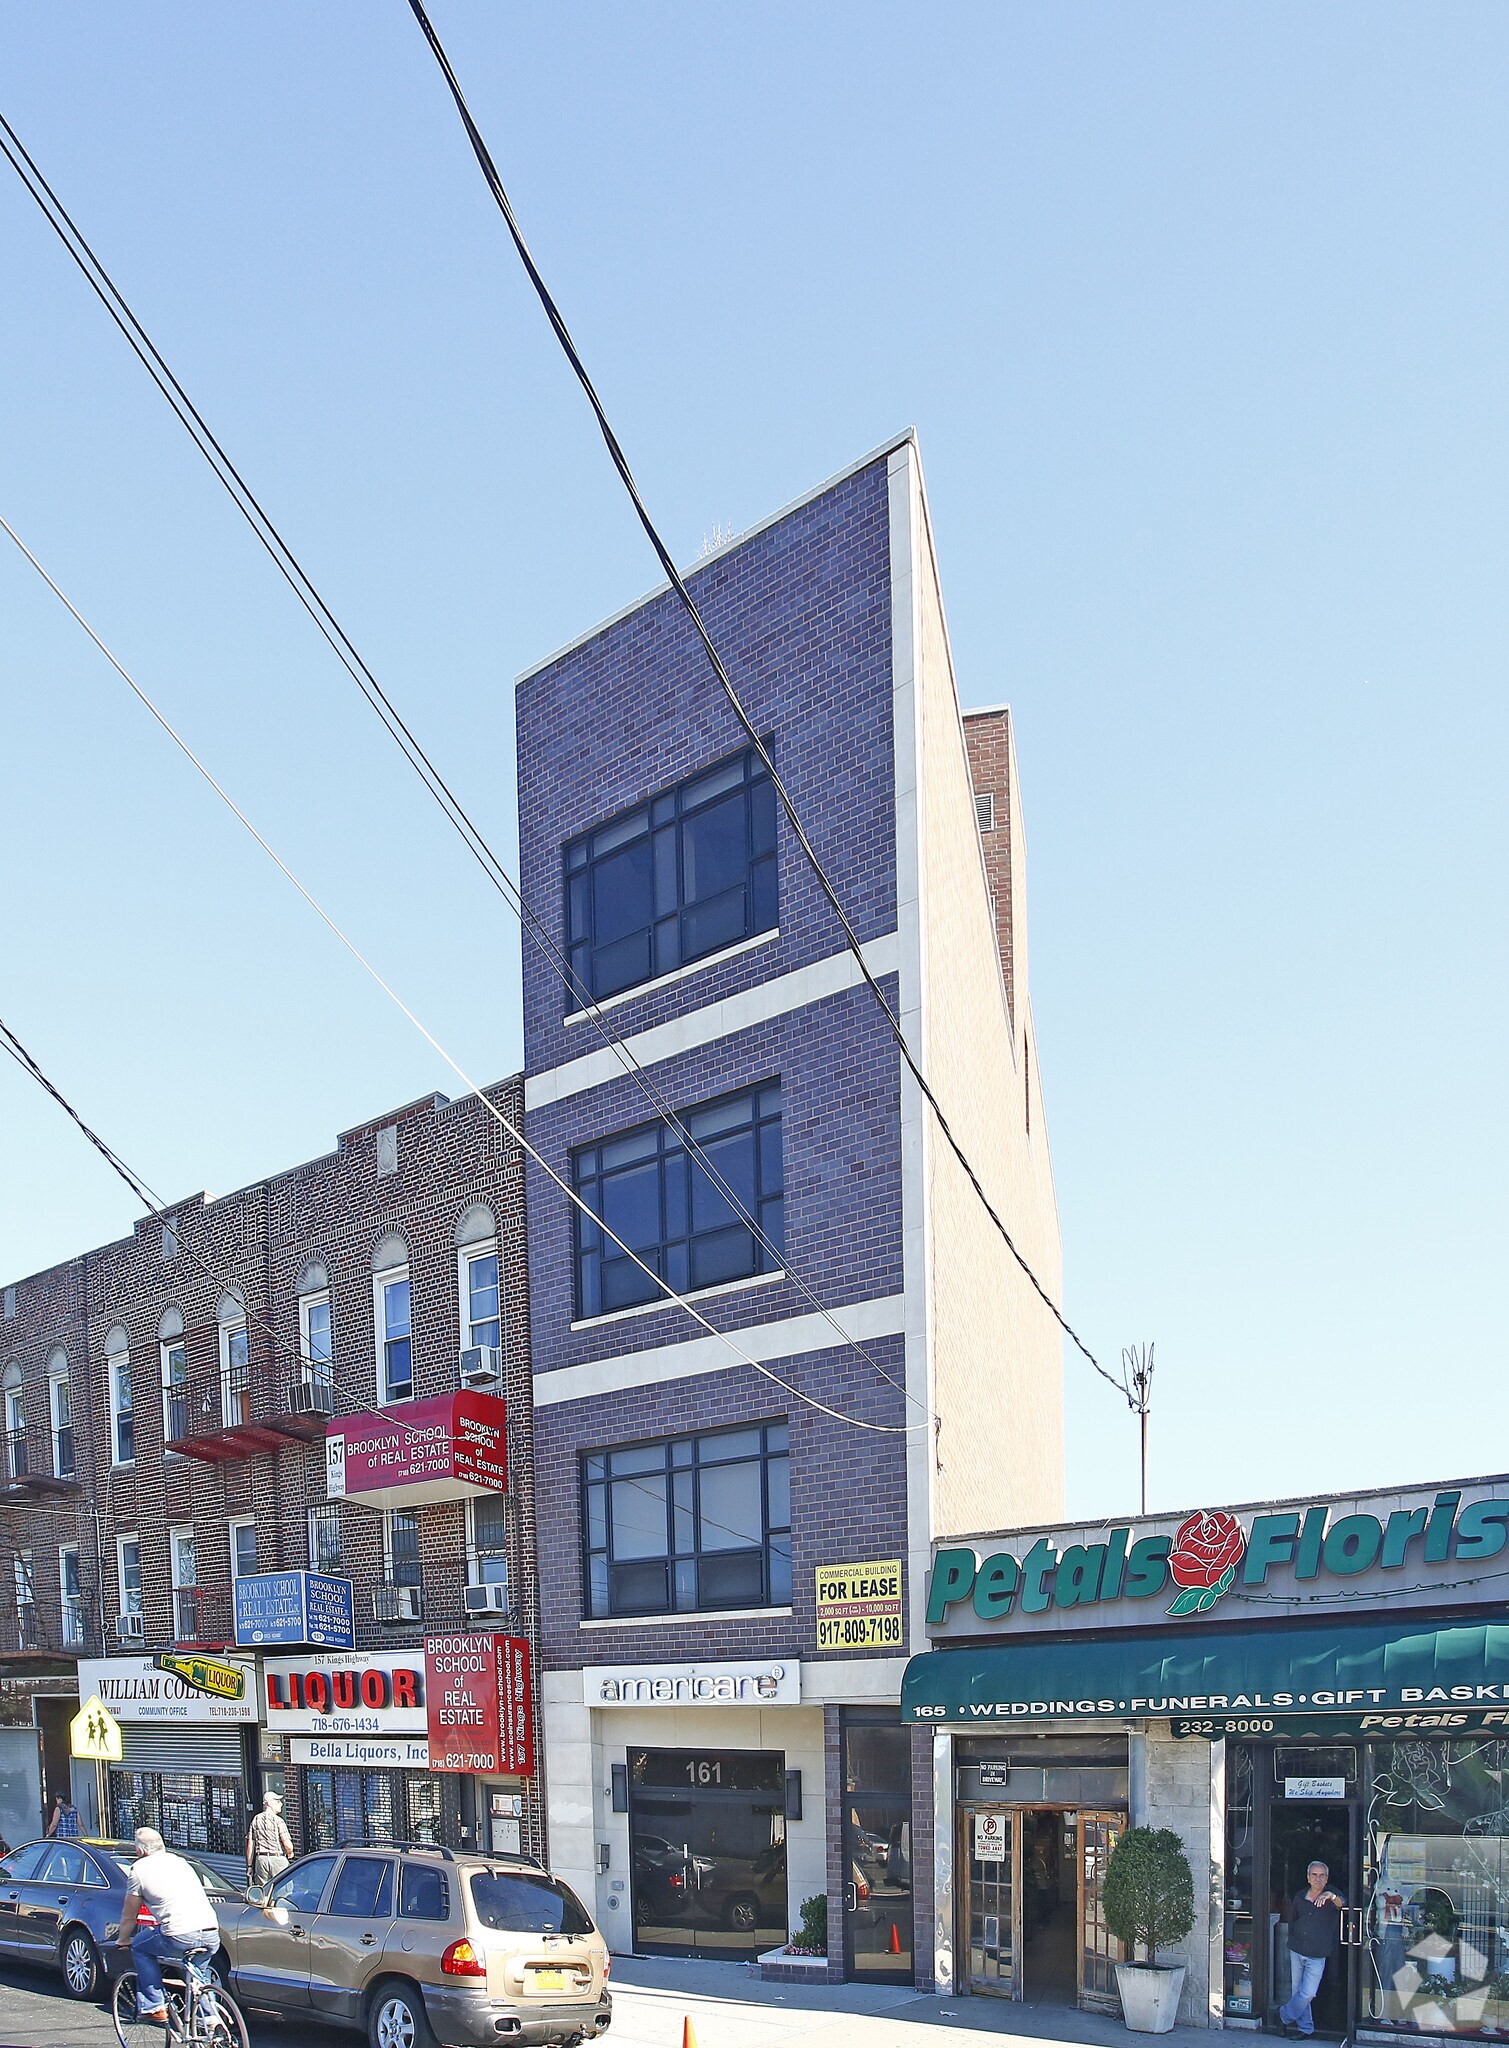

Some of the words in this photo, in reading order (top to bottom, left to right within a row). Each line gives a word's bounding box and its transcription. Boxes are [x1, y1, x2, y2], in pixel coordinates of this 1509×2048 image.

[459, 1416, 500, 1438] BROOKLYN
[347, 1434, 399, 1456] BROOKLYN
[404, 1425, 447, 1445] SCHOOL
[464, 1431, 497, 1449] SCHOOL
[327, 1441, 344, 1466] 157
[368, 1455, 379, 1468] of
[380, 1450, 407, 1465] REAL
[411, 1441, 449, 1460] ESTATE
[475, 1448, 483, 1457] of
[409, 1458, 450, 1474] 621-7000
[454, 1452, 475, 1466] REAL
[476, 1459, 504, 1476] ESTATE
[469, 1471, 503, 1489] 621-7000
[925, 1527, 1174, 1624] Petals
[1242, 1490, 1509, 1586] Floris
[819, 1568, 863, 1580] COMMERCIAL
[865, 1564, 897, 1576] BUILDING
[239, 1582, 272, 1599] BROOKLYN
[273, 1579, 299, 1597] SCHOOL
[309, 1579, 347, 1594] BROOKLYN
[819, 1582, 847, 1601] FOR
[851, 1577, 898, 1598] LEASE
[310, 1590, 346, 1604] SCHOOL
[243, 1601, 263, 1617] REAL
[265, 1598, 293, 1615] ESTATE
[309, 1602, 324, 1612] REAL
[325, 1604, 344, 1616] ESTATE
[820, 1606, 834, 1617] 2,000
[842, 1607, 848, 1615] FT
[865, 1604, 883, 1614] 10,000
[892, 1603, 899, 1611] FT
[276, 1617, 301, 1627] 621-5700
[318, 1614, 351, 1627] 621-7000
[318, 1622, 351, 1635] 621-5700
[819, 1616, 899, 1645] 917-809-7198
[427, 1636, 493, 1655] BROOKLYN
[314, 1655, 325, 1665] 157
[326, 1655, 344, 1666] Kings
[345, 1654, 370, 1666] Highway
[435, 1655, 487, 1673] SCHOOL
[208, 1669, 236, 1690] LIQUOR
[454, 1675, 464, 1688] of
[514, 1648, 524, 1702] Highway
[99, 1678, 160, 1700] WILLIAM
[267, 1668, 421, 1714] LIQUOR
[444, 1690, 477, 1707] REAL
[497, 1645, 506, 1763] www.brooklyn-school.com
[912, 1705, 946, 1717] 165
[969, 1699, 1115, 1716] WEDDINGS
[1130, 1691, 1294, 1711] FUNERALS
[1311, 1688, 1386, 1706] GIFT
[138, 1706, 168, 1716] COMMUNITY
[169, 1706, 188, 1716] OFFICE
[439, 1708, 484, 1725] ESTATE
[312, 1717, 380, 1731] 718-676-1434
[515, 1704, 526, 1742] Kings
[1179, 1719, 1274, 1734] 232-8000
[1359, 1712, 1469, 1729] Petals
[310, 1742, 343, 1758] Bella
[345, 1742, 401, 1762] Liquors,
[406, 1743, 428, 1760] Inc
[446, 1753, 494, 1769] 621-7000
[517, 1744, 526, 1765] 157
[685, 1761, 722, 1784] 161
[1297, 1779, 1310, 1788] Gift
[1312, 1779, 1332, 1787] Baskets
[1300, 1788, 1313, 1796] Ship
[1315, 1788, 1341, 1796] Anywhere
